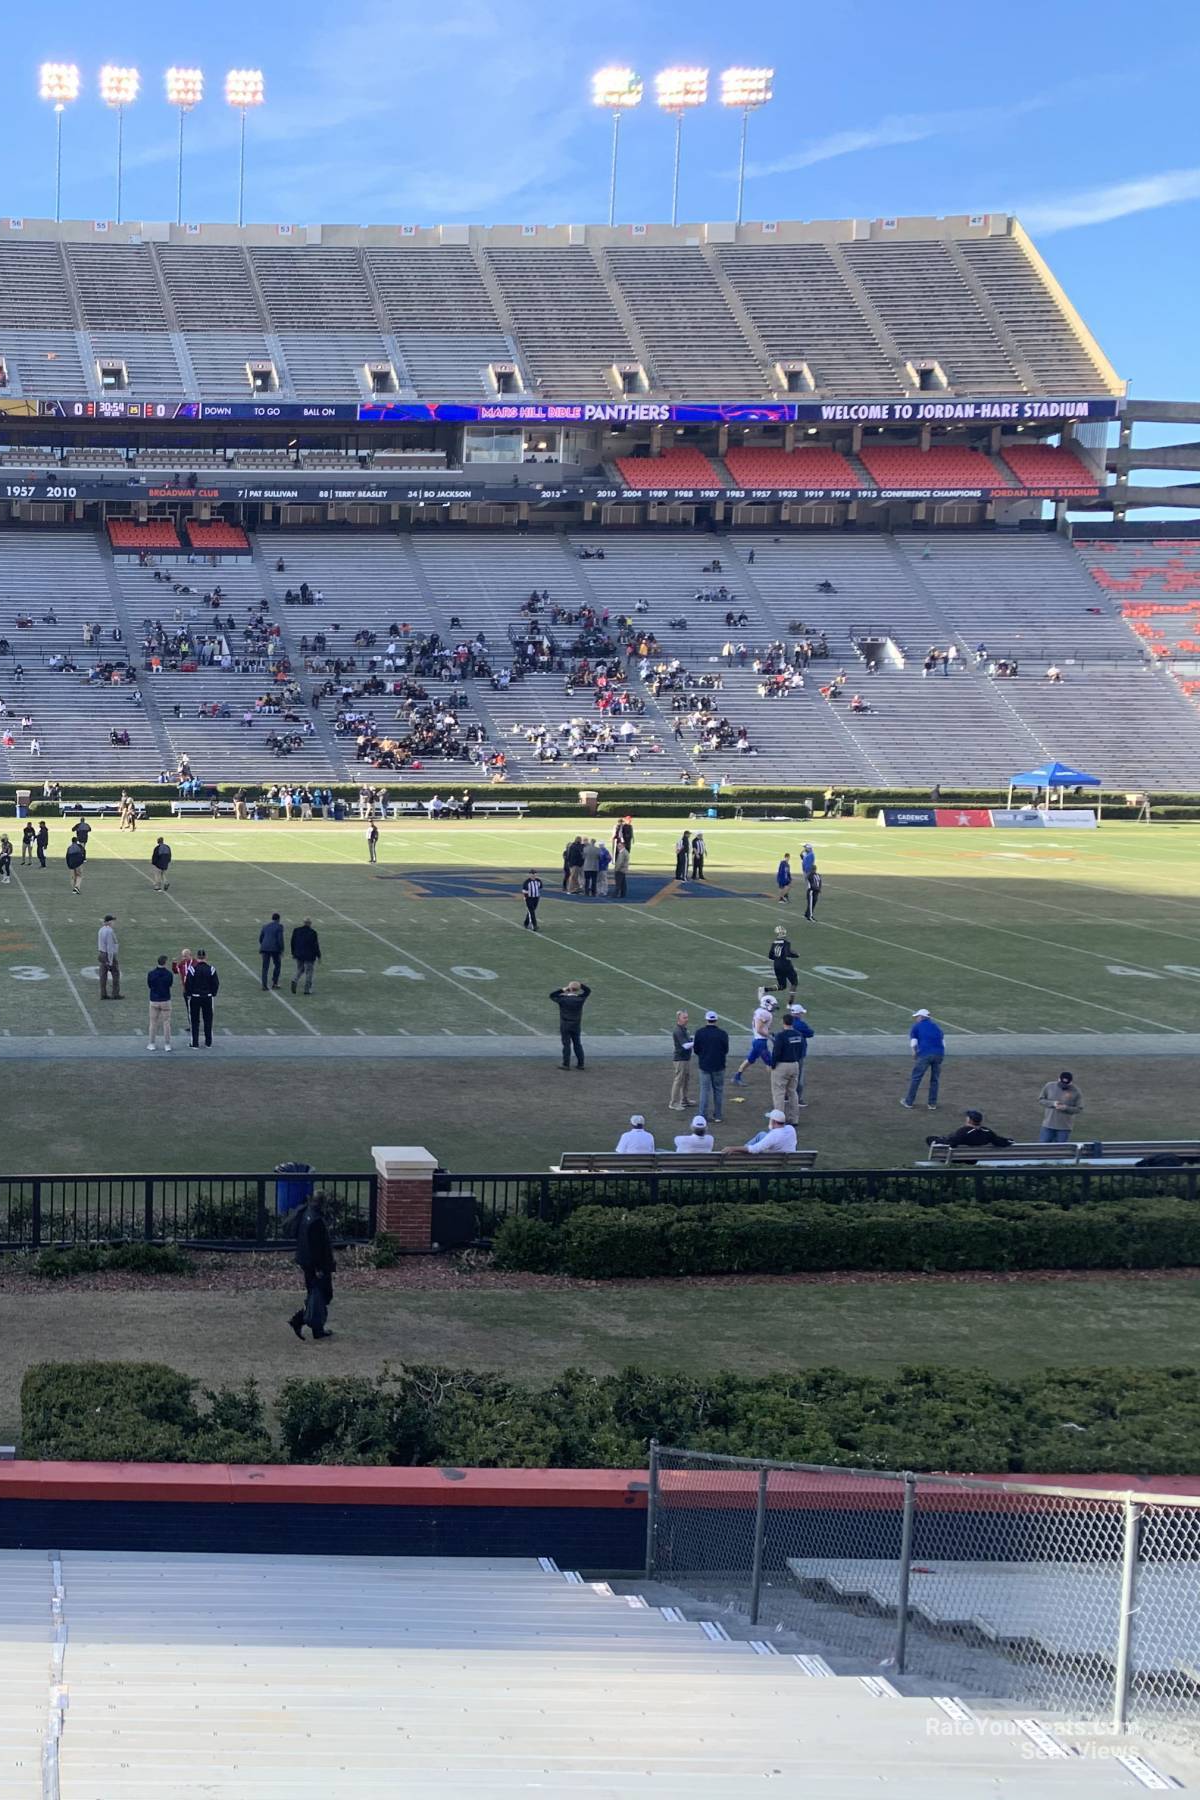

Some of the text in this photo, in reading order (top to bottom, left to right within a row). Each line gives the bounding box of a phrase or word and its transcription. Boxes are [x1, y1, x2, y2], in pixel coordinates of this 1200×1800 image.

[74, 403, 82, 416] 0
[100, 402, 124, 412] 30:54
[157, 404, 165, 416] 0
[482, 404, 670, 420] MARS HILL BIBLE PANTHERS
[821, 402, 1088, 420] WELCOME TO JORDAN-HARE STADIUM
[6, 486, 36, 496] 1957
[46, 487, 77, 497] 2010
